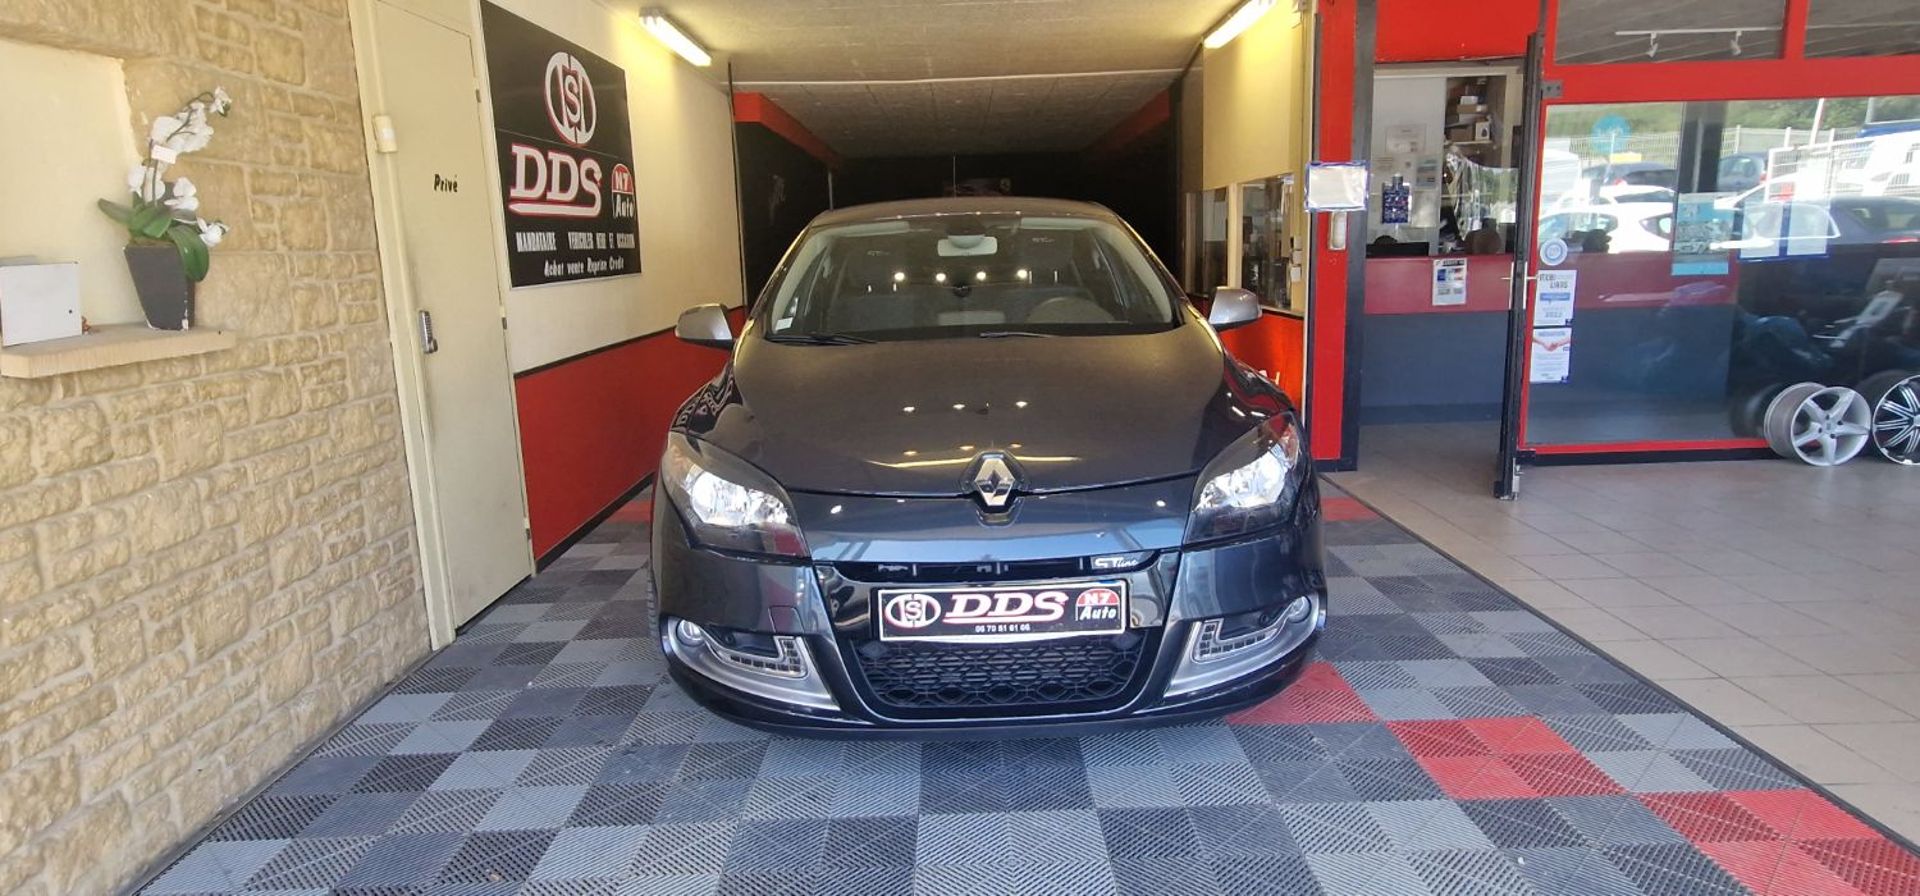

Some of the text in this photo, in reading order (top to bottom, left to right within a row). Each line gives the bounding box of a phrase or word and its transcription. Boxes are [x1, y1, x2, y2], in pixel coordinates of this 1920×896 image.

[434, 173, 458, 193] Privé
[509, 143, 602, 217] DDS
[615, 194, 635, 218] Auto
[544, 259, 564, 277] Achat
[942, 591, 1069, 624] DDS
[1084, 592, 1111, 605] N7
[1080, 605, 1117, 620] Auto
